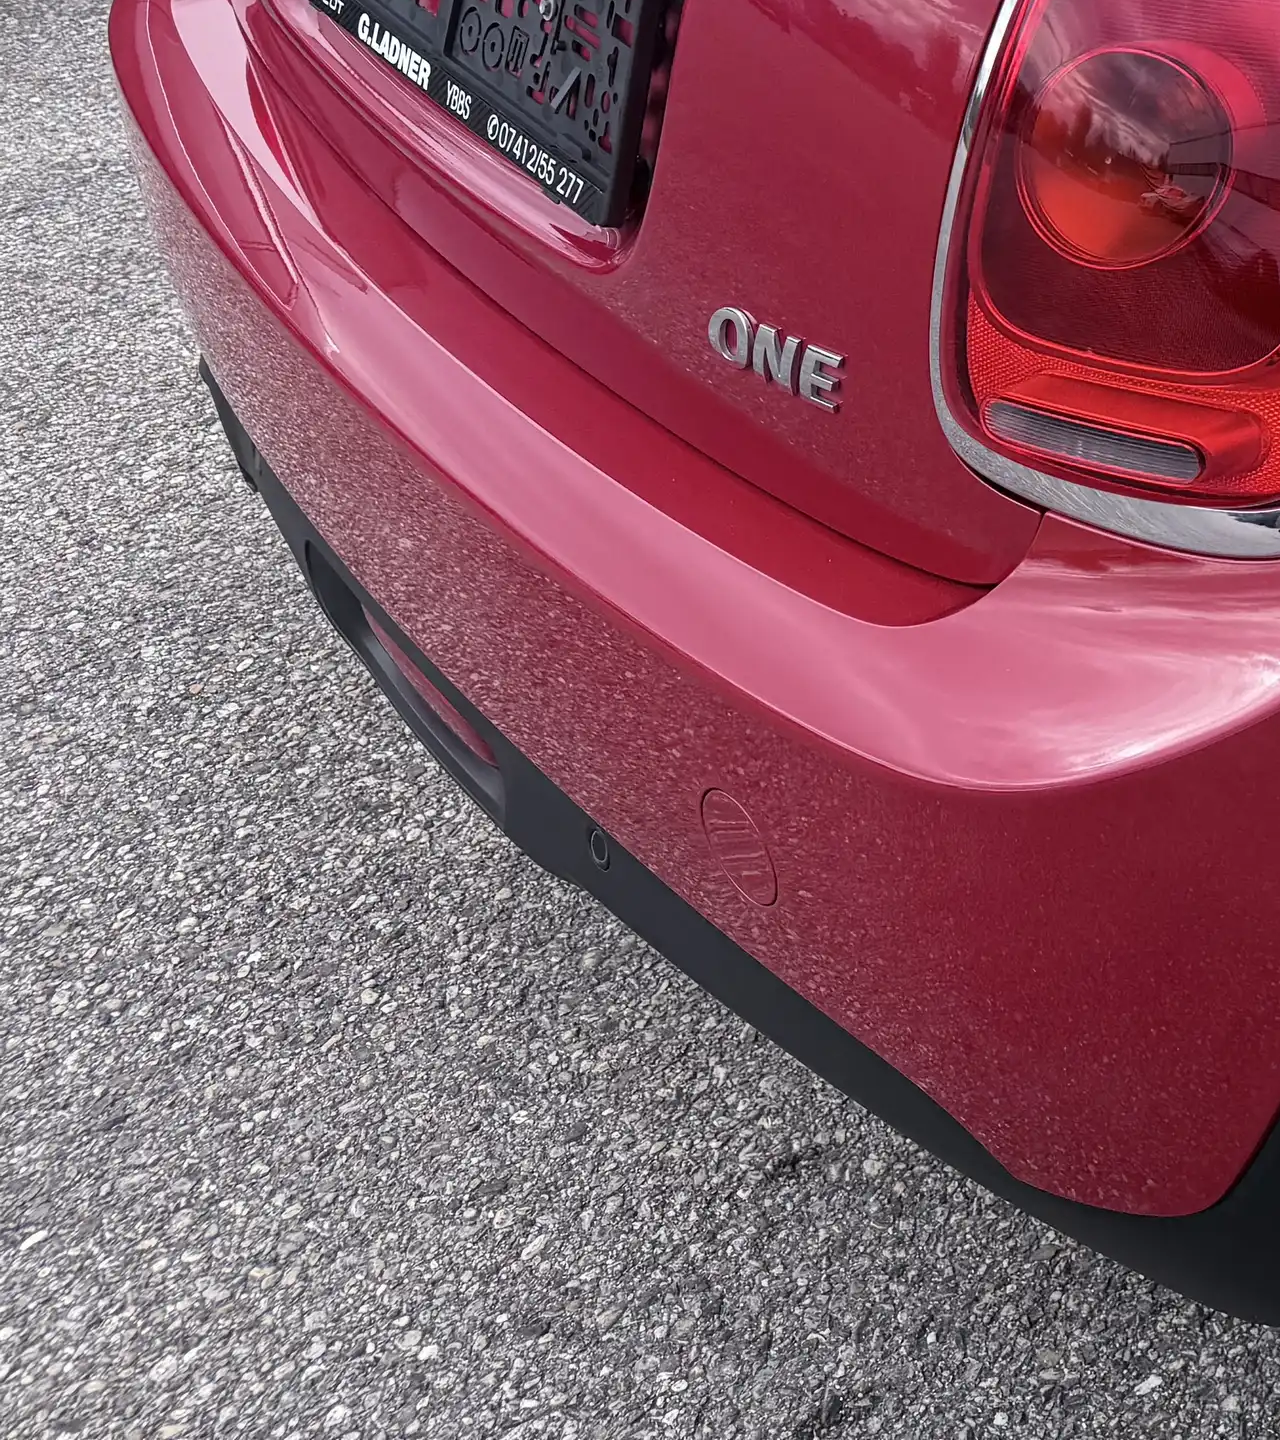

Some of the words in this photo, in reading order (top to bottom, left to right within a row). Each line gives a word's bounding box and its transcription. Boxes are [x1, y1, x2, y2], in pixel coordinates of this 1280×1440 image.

[357, 12, 432, 91] G.LADNER
[446, 79, 472, 121] YBBS
[498, 121, 557, 186] 07412/55
[556, 166, 585, 204] 277
[708, 306, 845, 414] ONE
